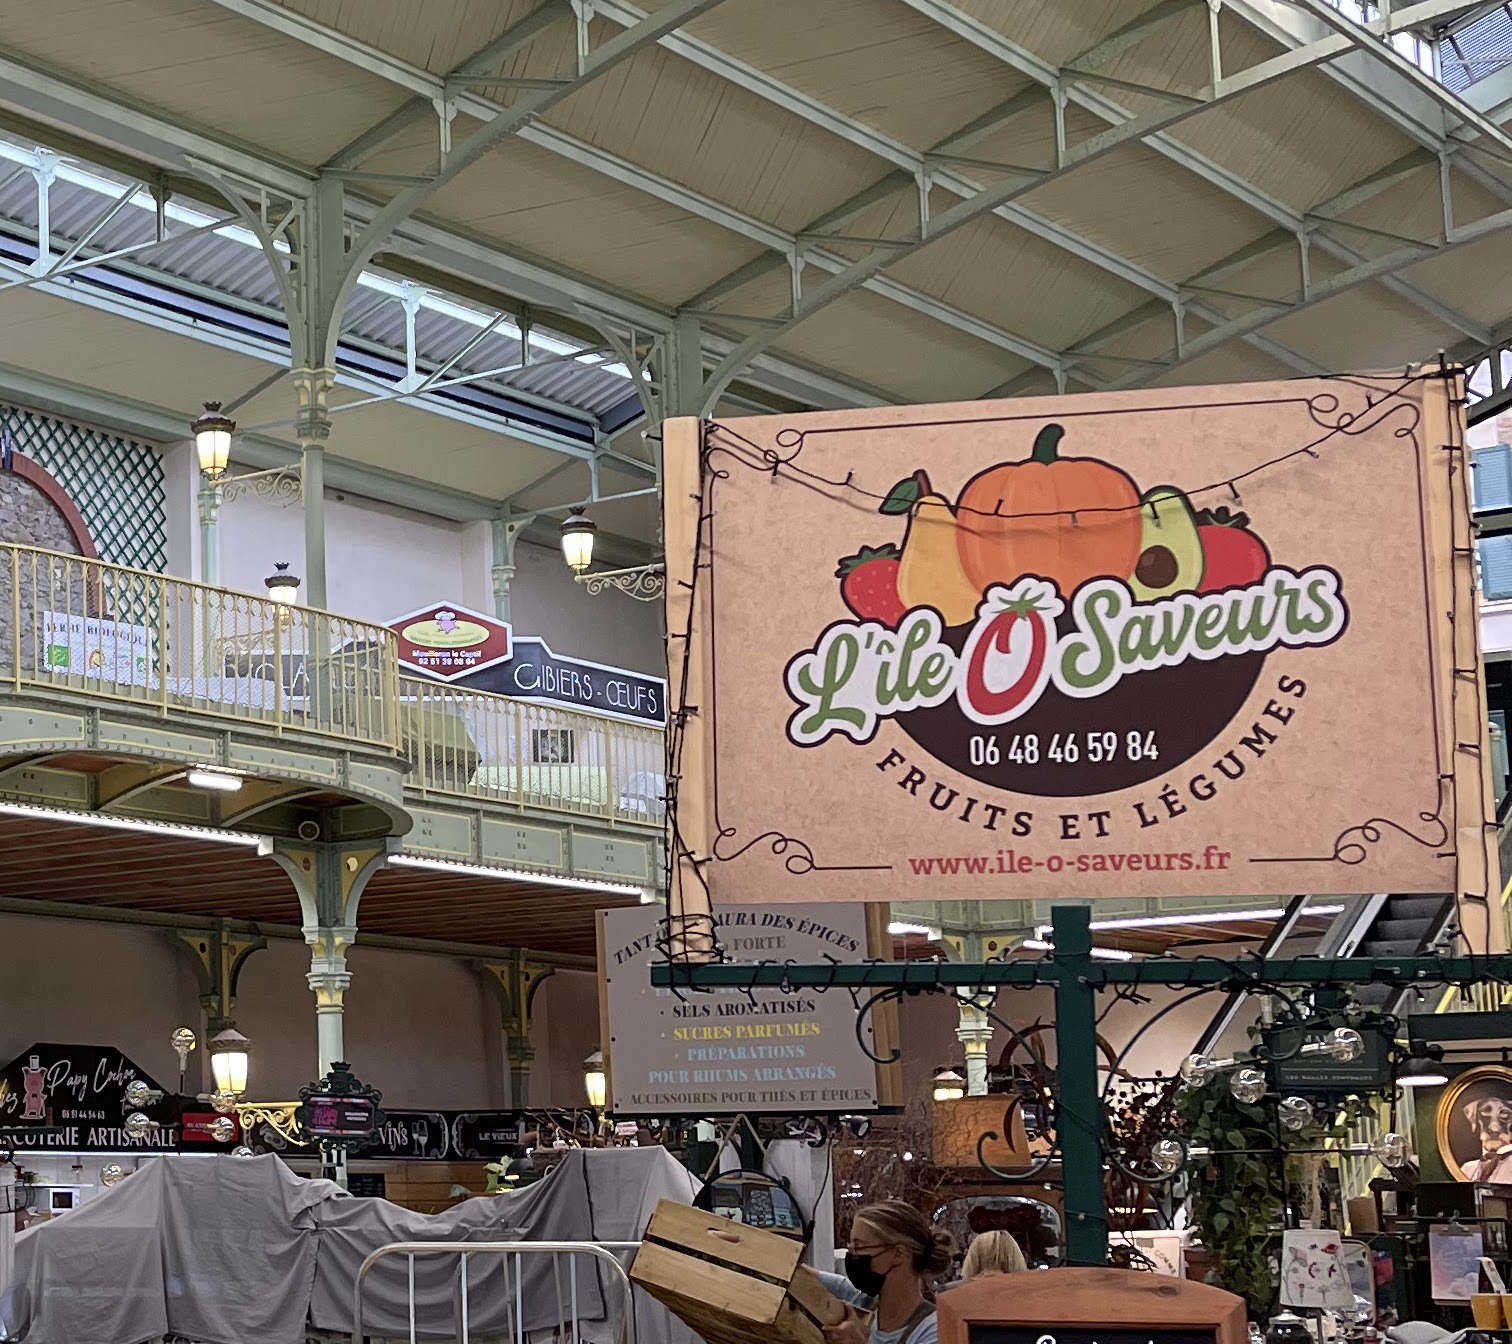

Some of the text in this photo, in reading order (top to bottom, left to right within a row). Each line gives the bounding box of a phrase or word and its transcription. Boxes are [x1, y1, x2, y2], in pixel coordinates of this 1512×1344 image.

[1060, 574, 1337, 690] Saveurs
[513, 663, 658, 714] GIBIERS ŒUFS
[875, 674, 1310, 841] FRUITS ET LÉGUMES
[969, 730, 1160, 766] 06 48 46 59 84
[908, 844, 1233, 877] www.ile-o-saveurs.fr
[733, 936, 786, 952] FORTE
[761, 913, 794, 930] DES
[797, 917, 860, 953] ÉPICES
[673, 999, 816, 1018] SELS AROMATISÉS
[674, 1020, 821, 1041] SUCRES PARFUMÉS
[688, 1044, 806, 1062] PRÉPARATIONS
[46, 1059, 89, 1102] Papy
[649, 1063, 837, 1084] POUR RHUMS ARRANGÉS
[630, 1086, 872, 1105] ACCESSOIRES POUR ET ÉPICES
[87, 1127, 177, 1149] ARTISANALE
